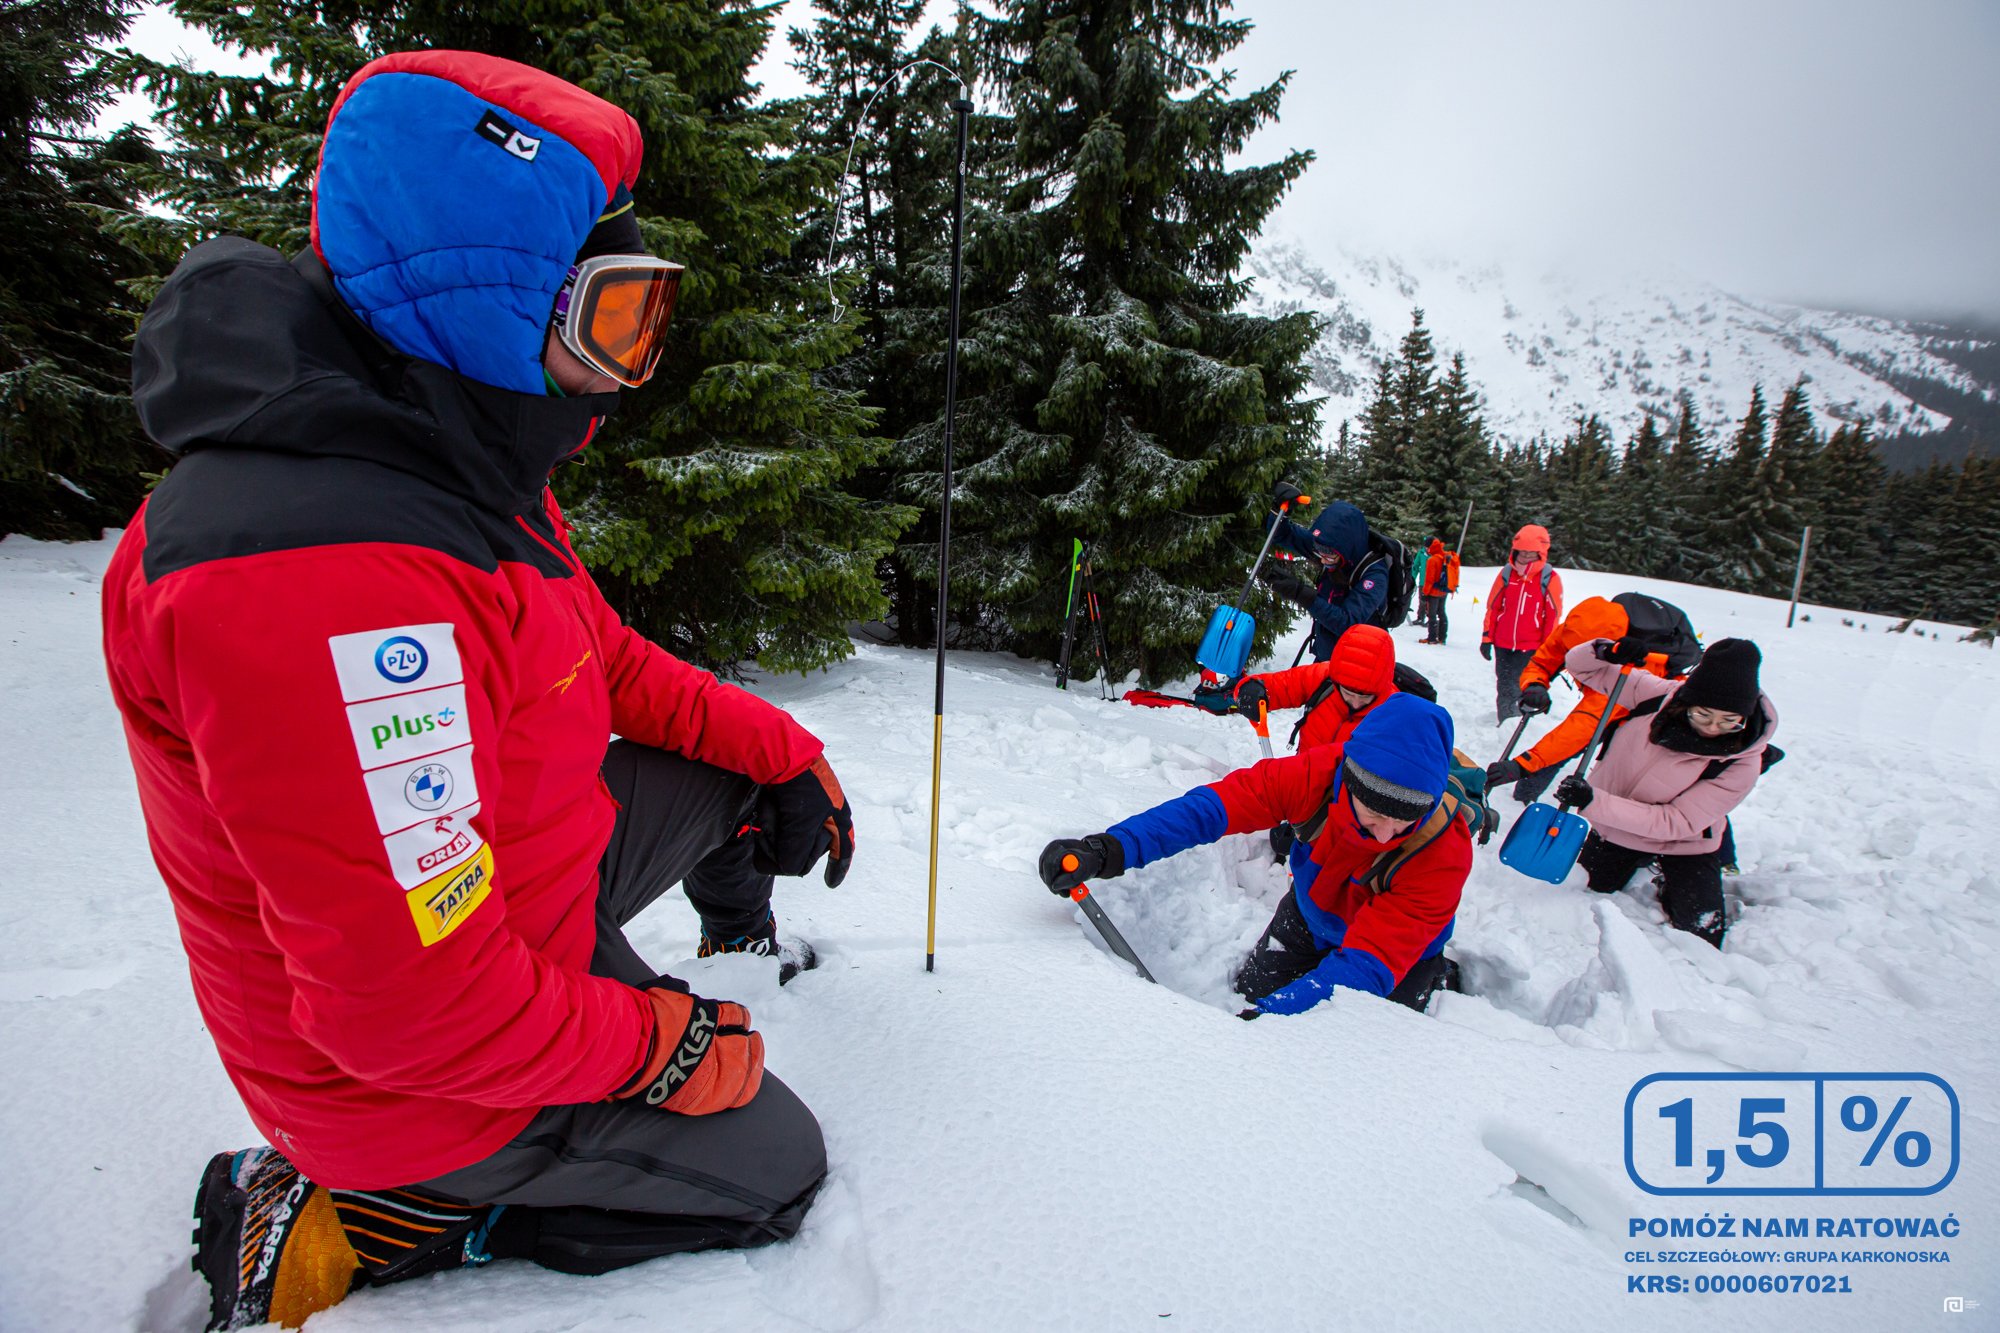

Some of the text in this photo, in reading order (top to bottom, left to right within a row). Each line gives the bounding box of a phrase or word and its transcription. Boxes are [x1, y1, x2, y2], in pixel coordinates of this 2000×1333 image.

[387, 649, 418, 671] PZU
[371, 714, 436, 750] plus
[409, 765, 447, 785] BMW
[420, 833, 470, 869] ORLEN
[434, 864, 484, 919] TATRA
[646, 1007, 716, 1106] OAKLEY
